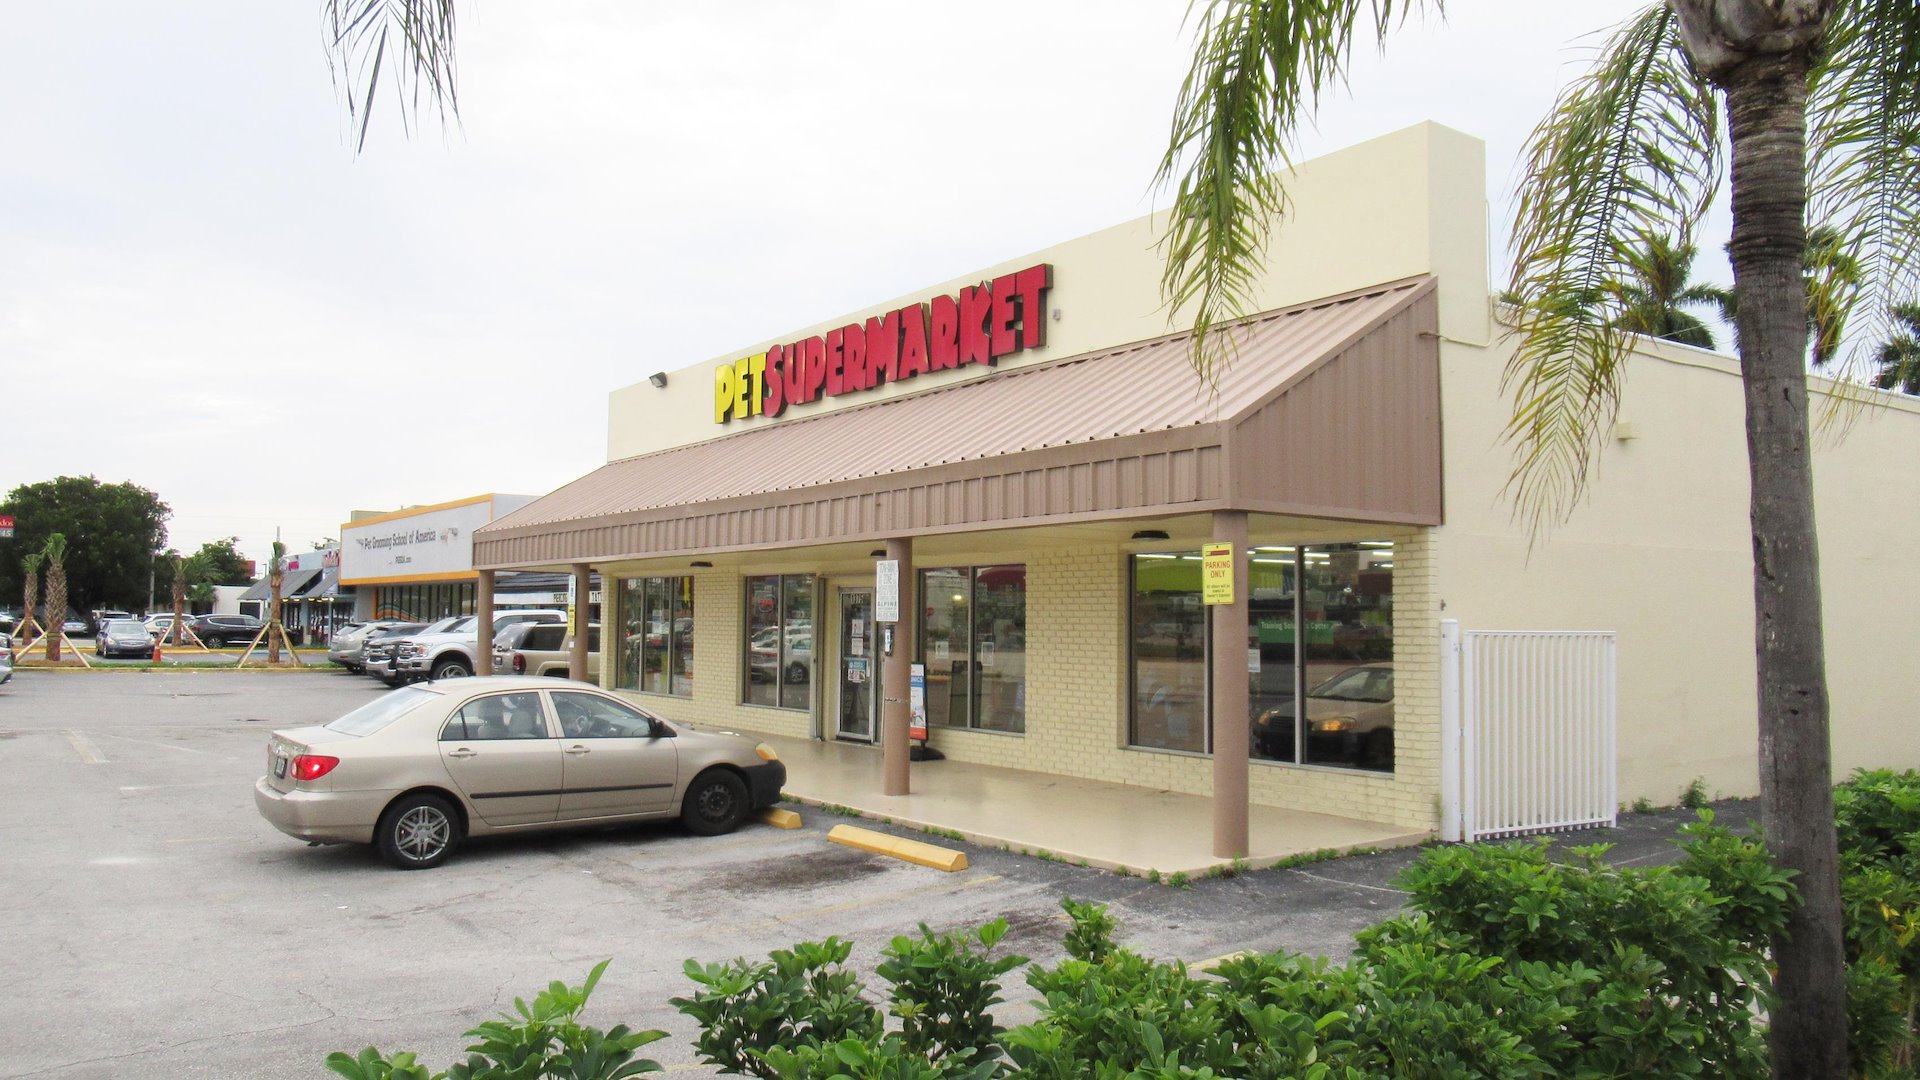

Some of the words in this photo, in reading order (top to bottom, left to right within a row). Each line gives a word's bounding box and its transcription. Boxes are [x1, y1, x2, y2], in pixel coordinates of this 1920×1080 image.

[372, 536, 392, 550] Grooming
[392, 532, 407, 547] School
[408, 530, 415, 544] of
[415, 530, 436, 544] America
[1205, 560, 1231, 569] PARKING
[1210, 570, 1225, 578] ONLY
[1261, 621, 1283, 631] Training
